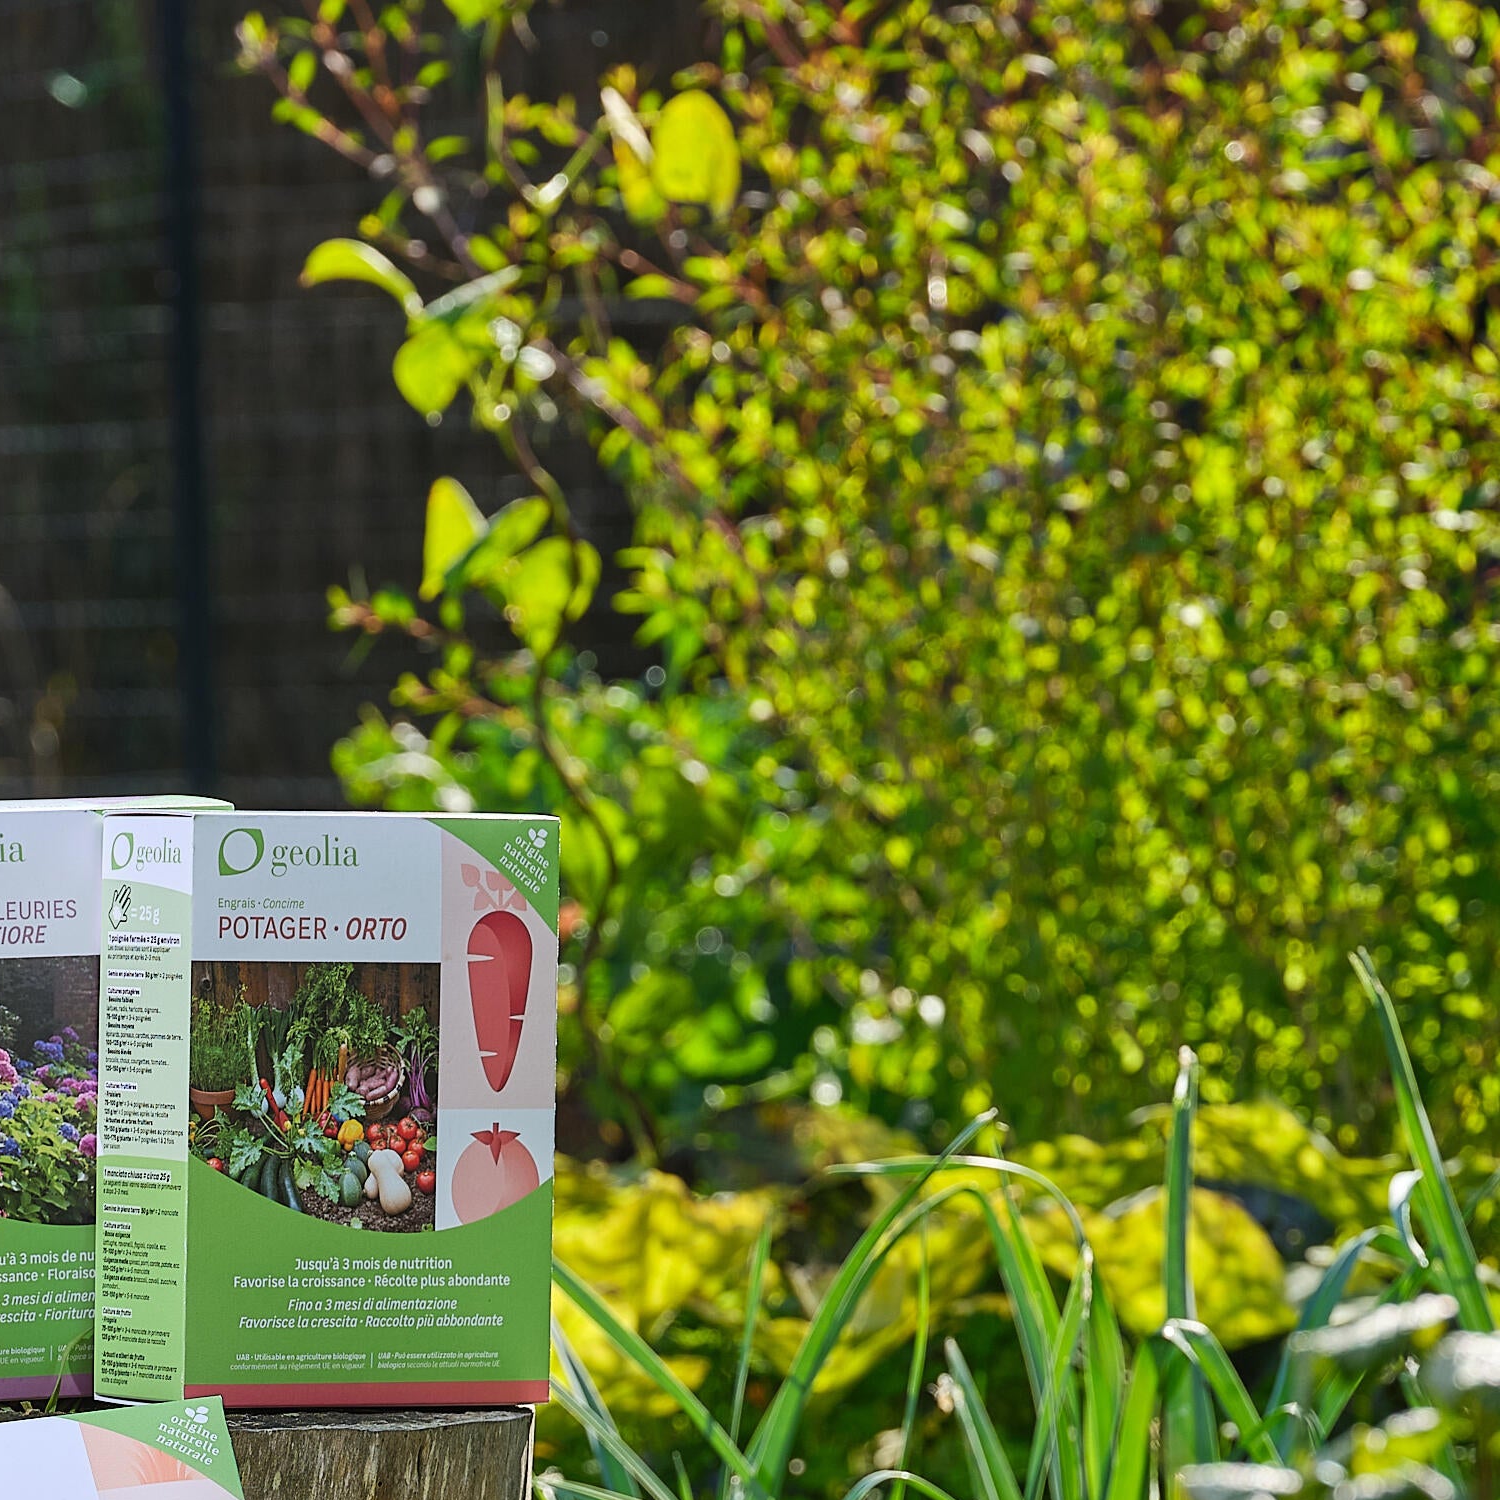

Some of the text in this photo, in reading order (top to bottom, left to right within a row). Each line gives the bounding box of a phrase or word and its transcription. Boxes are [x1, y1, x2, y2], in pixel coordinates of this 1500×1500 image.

[136, 838, 181, 870] geolia
[271, 834, 358, 876] geolia
[504, 842, 547, 884] naturelle
[516, 836, 549, 868] origine
[500, 856, 540, 893] naturale
[218, 897, 304, 910] Engrais Concime
[219, 916, 406, 940] POTAGER ORTO
[295, 1256, 451, 1272] Jusqu'à 3 mois de nutrition
[234, 1273, 509, 1289] Favorise la croissance Récolte plus abondante
[288, 1297, 456, 1310] Fino a 3 mesi di alimentazione
[239, 1313, 502, 1329] Favorisce la crescita Raccolto più abbondante
[159, 1423, 219, 1456] naturelle
[171, 1416, 218, 1441] origine
[156, 1433, 212, 1465] naturale
